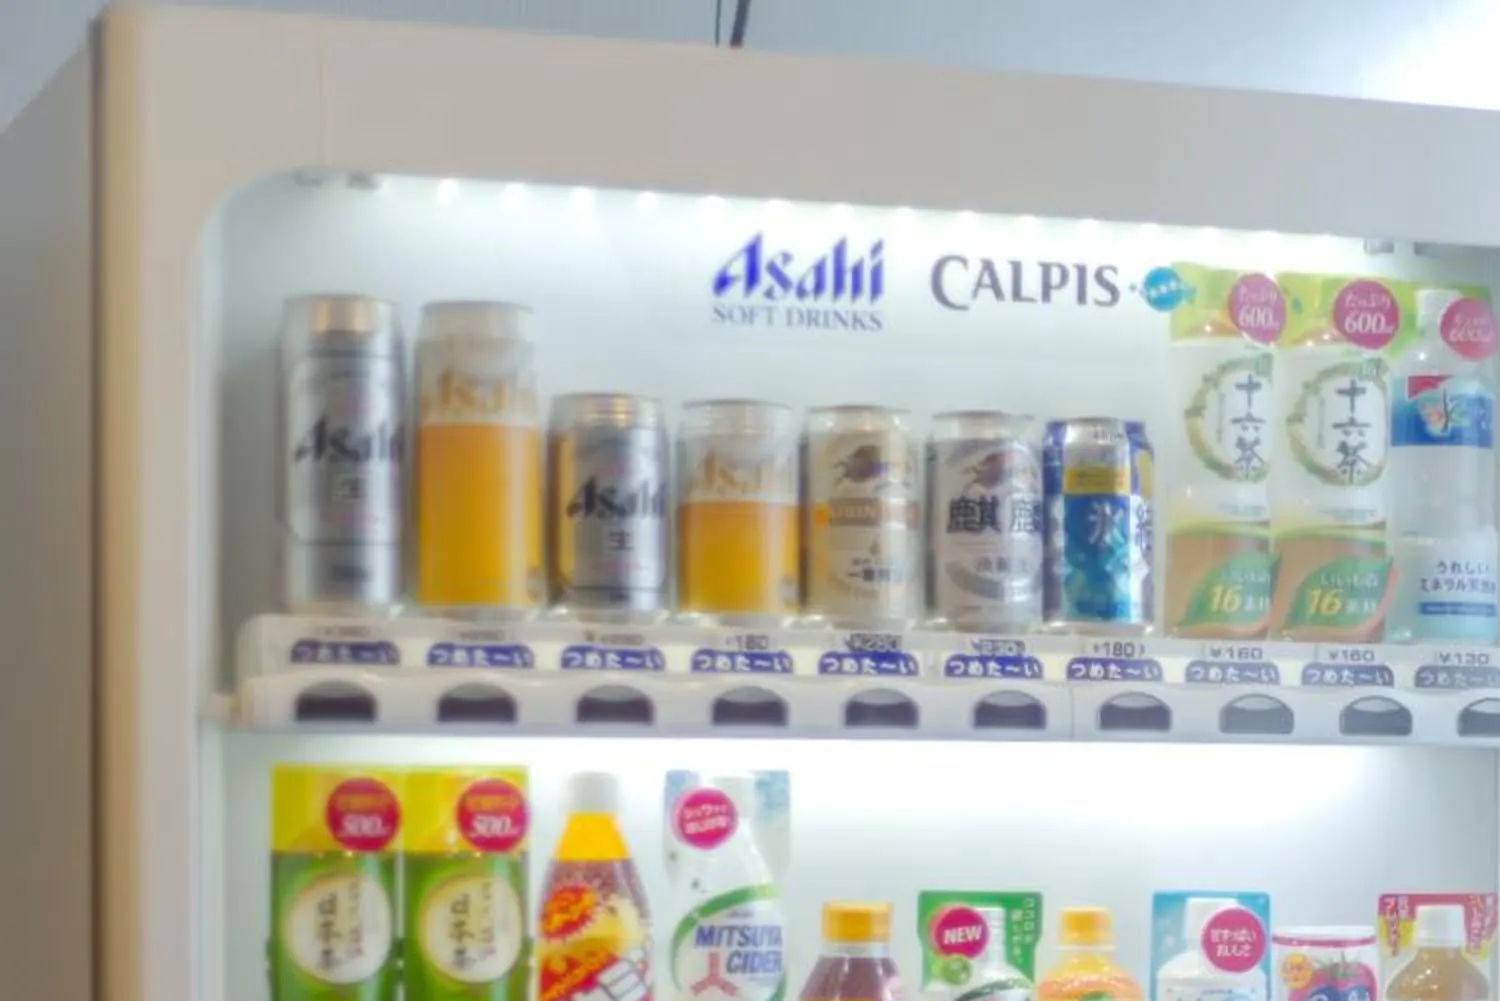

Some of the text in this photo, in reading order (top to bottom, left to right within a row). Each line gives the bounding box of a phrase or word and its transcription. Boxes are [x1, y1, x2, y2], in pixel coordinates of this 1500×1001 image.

[712, 231, 885, 302] Asahi
[930, 254, 1120, 311] CALPIS
[712, 303, 884, 332] SOFT DRINKS
[943, 925, 983, 946] NEW
